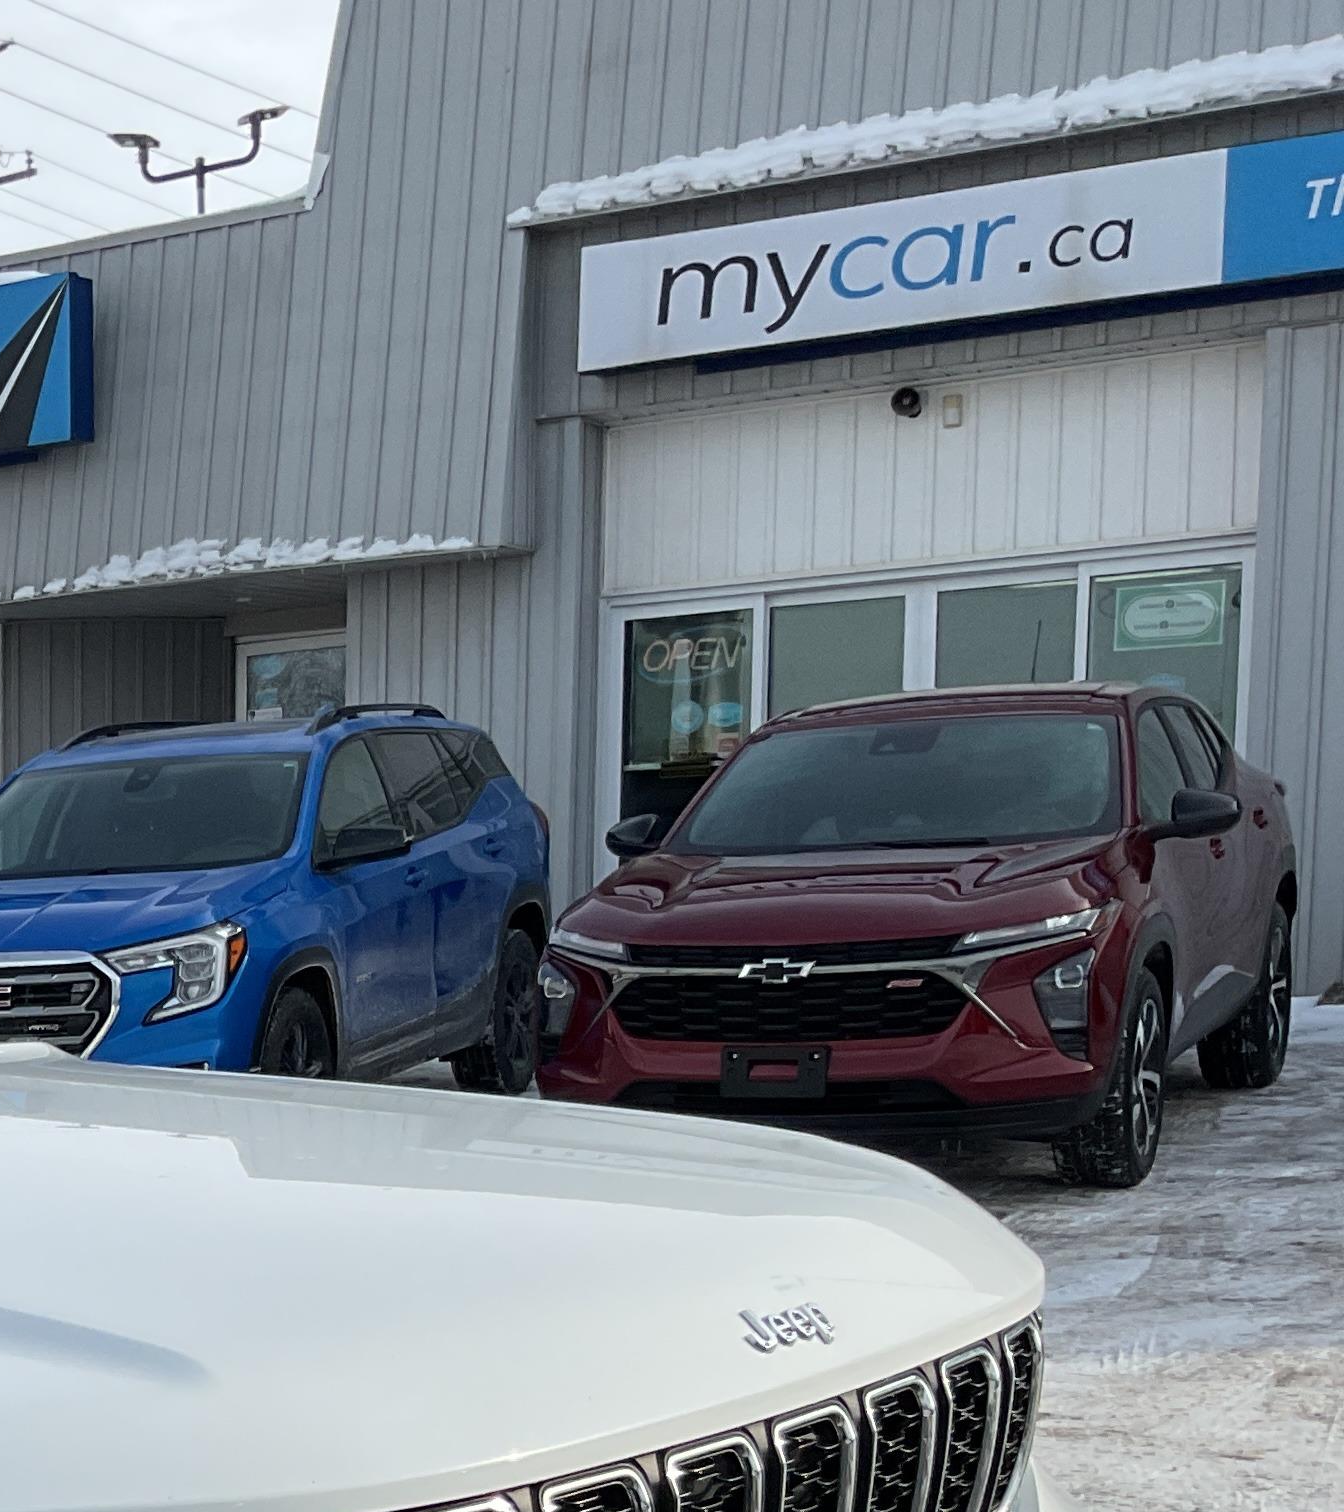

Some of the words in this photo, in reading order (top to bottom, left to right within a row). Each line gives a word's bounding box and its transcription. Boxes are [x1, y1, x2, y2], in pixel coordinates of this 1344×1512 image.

[656, 214, 1134, 334] mycar.ca
[643, 636, 743, 672] OPEN
[738, 1302, 835, 1354] Jeep
